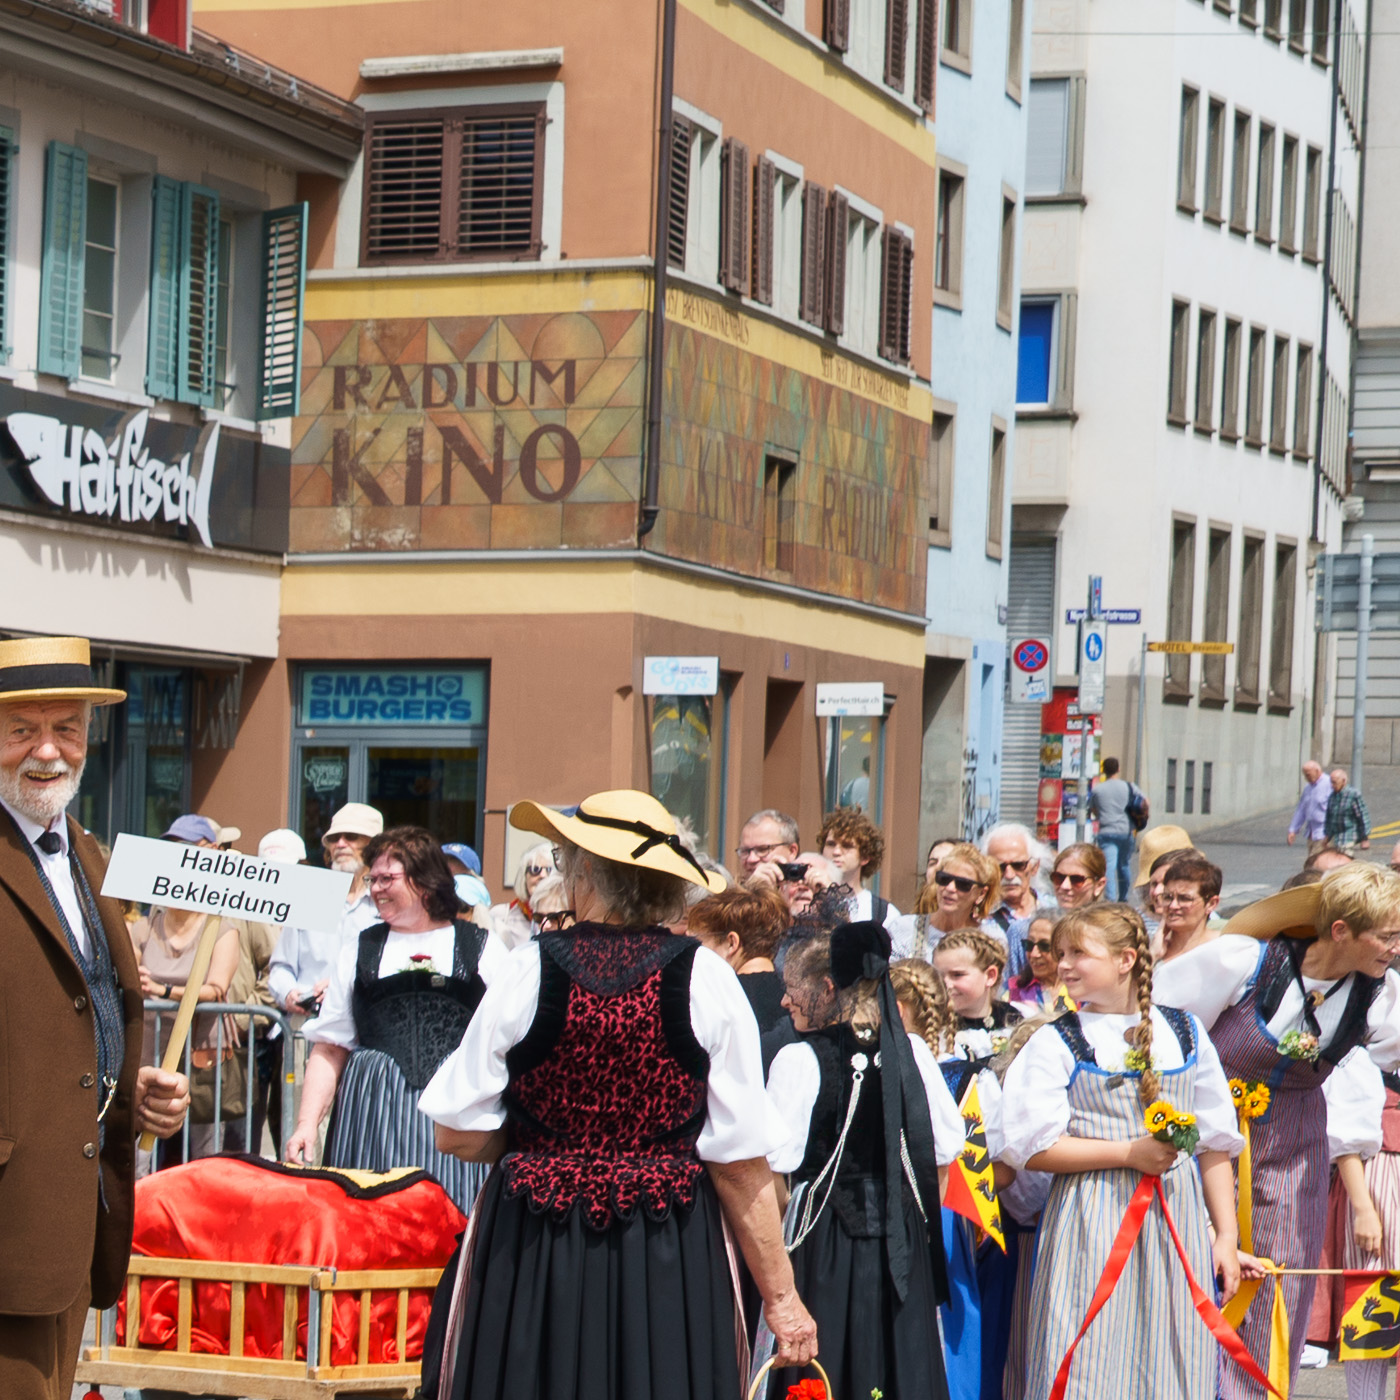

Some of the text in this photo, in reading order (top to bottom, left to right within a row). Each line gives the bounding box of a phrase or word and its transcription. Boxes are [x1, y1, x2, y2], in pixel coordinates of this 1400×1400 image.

[333, 360, 577, 411] RADIUM
[50, 409, 219, 548] Haifisch
[332, 423, 582, 507] KINO
[697, 433, 757, 530] KINO
[822, 473, 901, 571] RADIUM
[1157, 643, 1185, 652] HOTEL
[309, 698, 472, 721] BURGERS
[310, 674, 433, 697] SMASH
[180, 848, 281, 885] Halblein
[151, 876, 291, 923] Bekleidung
